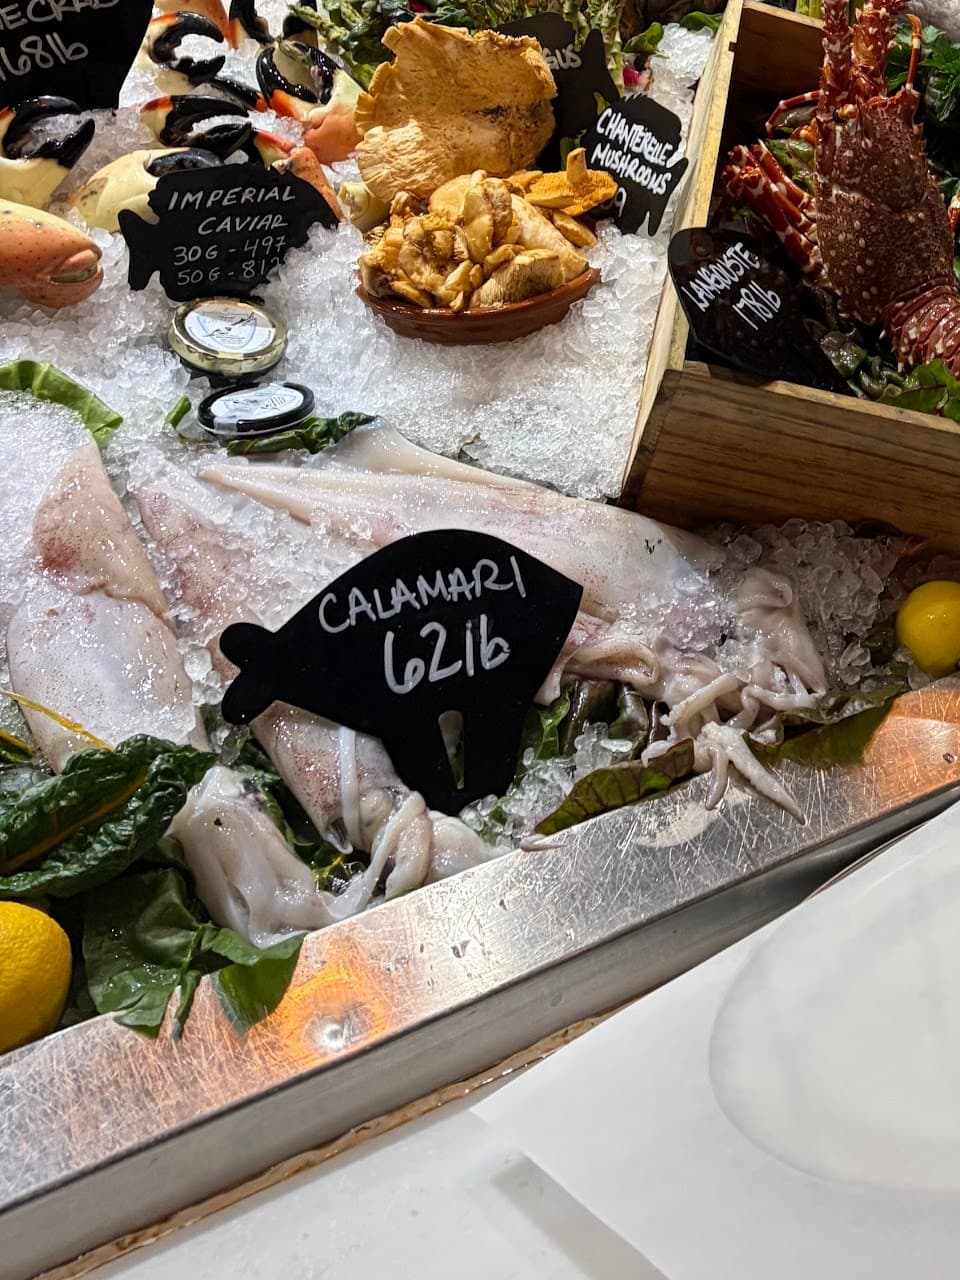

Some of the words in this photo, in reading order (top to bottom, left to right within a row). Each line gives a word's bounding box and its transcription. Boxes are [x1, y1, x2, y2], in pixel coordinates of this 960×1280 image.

[0, 31, 89, 81] 68lb
[590, 142, 673, 196] MUSHROOMS
[168, 185, 296, 211] IMPERIAL
[198, 214, 289, 236] CAVIAR
[318, 555, 527, 634] CALAMARI
[384, 613, 511, 695] 62lb
